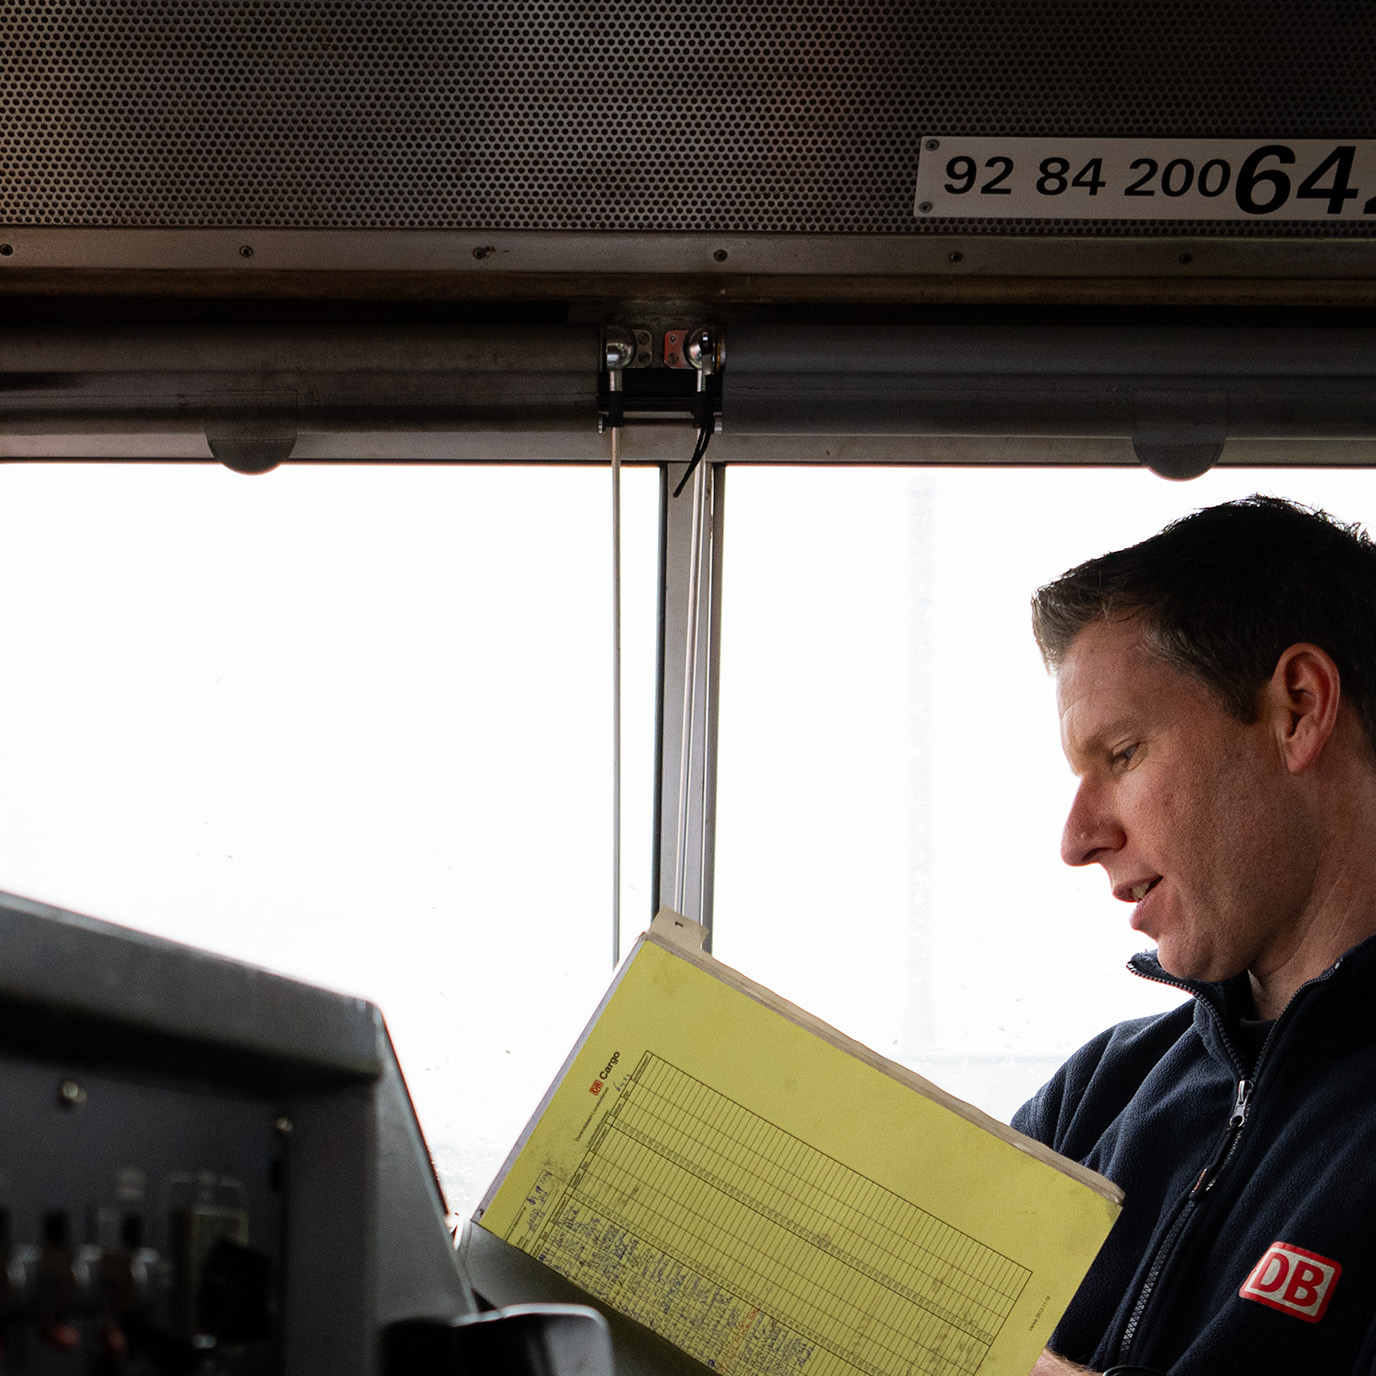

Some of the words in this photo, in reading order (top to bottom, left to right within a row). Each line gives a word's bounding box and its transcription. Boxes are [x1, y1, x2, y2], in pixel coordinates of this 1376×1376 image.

[944, 154, 1014, 196] 92
[1036, 156, 1106, 197] 84
[598, 1051, 621, 1080] Cargo
[1248, 1250, 1327, 1308] DB
